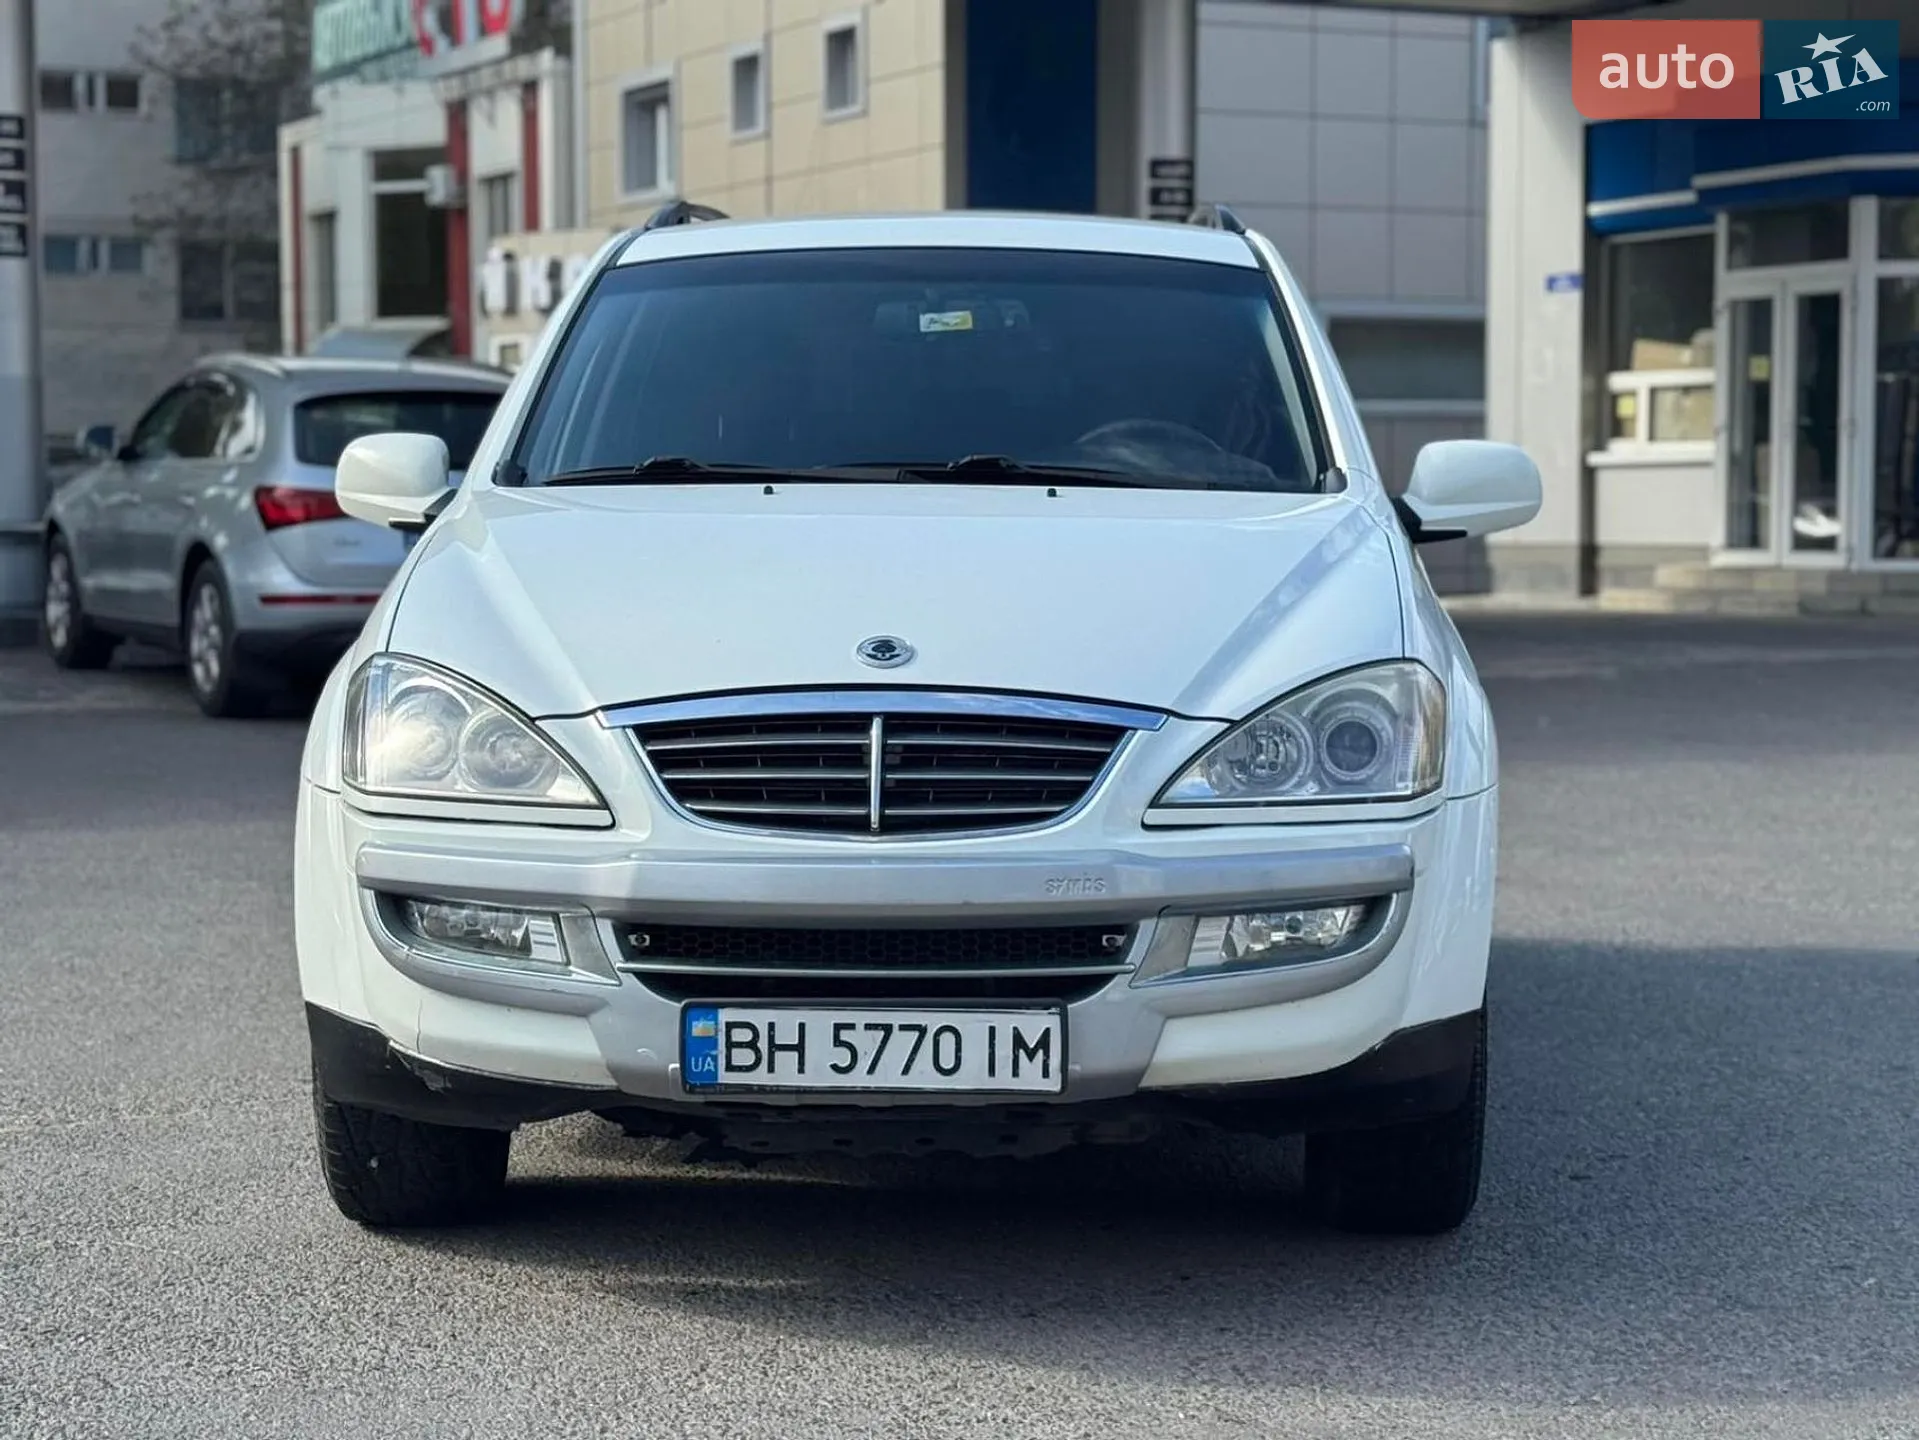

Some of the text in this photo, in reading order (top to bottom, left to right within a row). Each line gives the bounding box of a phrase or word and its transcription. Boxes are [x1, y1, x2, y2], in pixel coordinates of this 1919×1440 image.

[691, 1056, 716, 1073] UA
[724, 1020, 1051, 1079] BH 5770 IM
